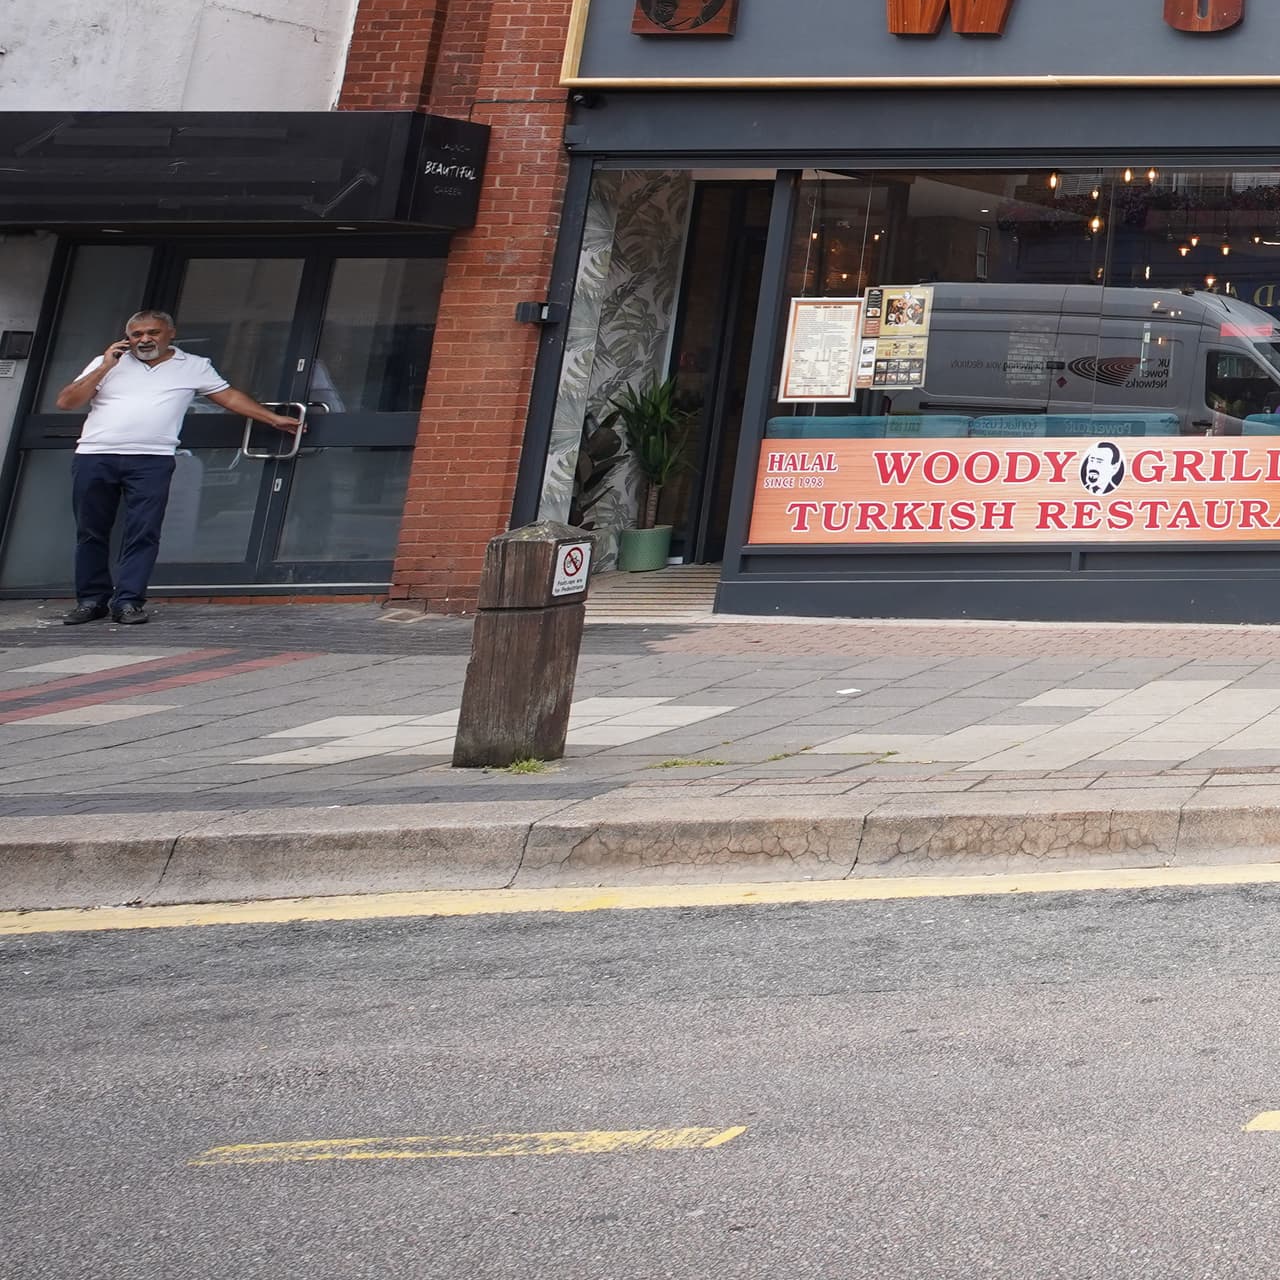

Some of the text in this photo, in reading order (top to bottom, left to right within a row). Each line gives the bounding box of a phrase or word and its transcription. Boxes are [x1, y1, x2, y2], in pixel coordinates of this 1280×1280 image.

[424, 160, 477, 180] BEAUTIFUL
[768, 452, 838, 473] HALAL
[873, 450, 1078, 486] WOODY
[764, 476, 825, 489] SINCE 1998
[787, 500, 1017, 533] TURKISH
